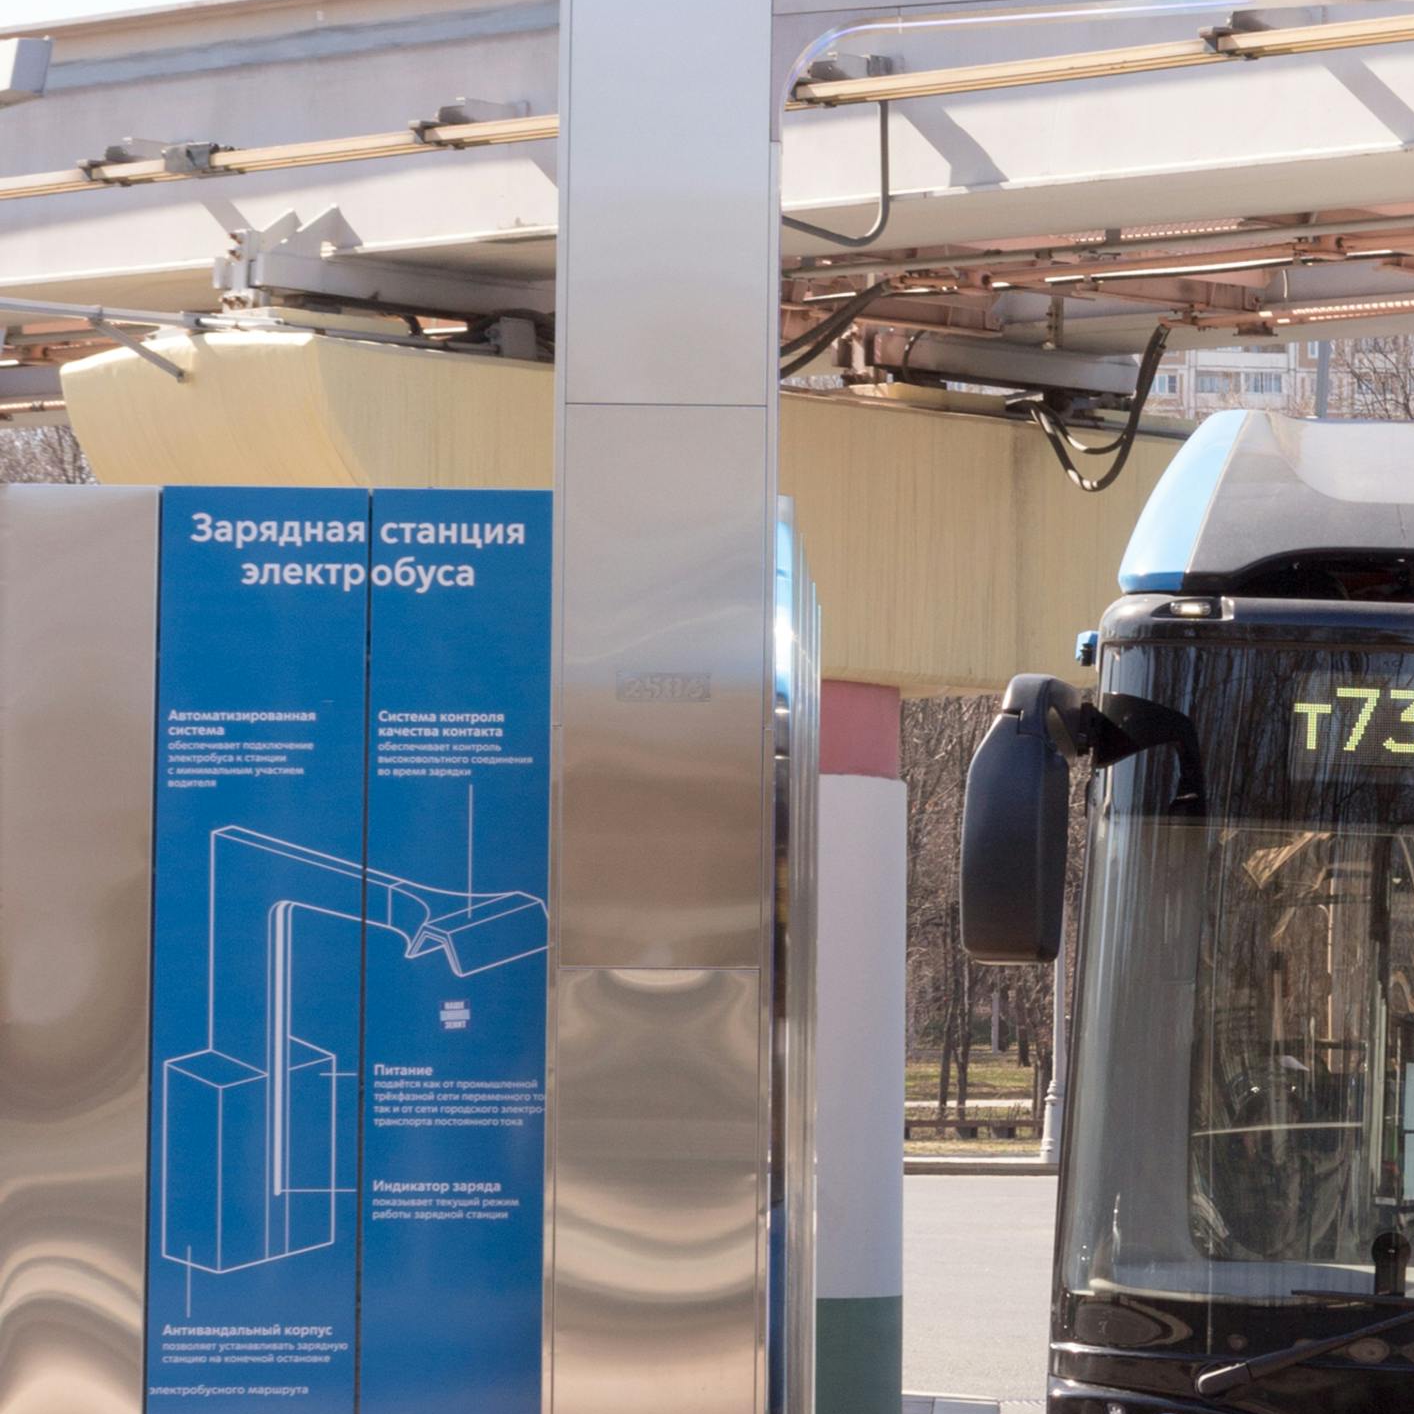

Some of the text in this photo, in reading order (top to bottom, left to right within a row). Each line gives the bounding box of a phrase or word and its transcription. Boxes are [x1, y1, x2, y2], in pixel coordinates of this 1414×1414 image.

[191, 512, 525, 549] Зарядная станция
[241, 556, 475, 593] электробуса
[168, 709, 316, 723] Автоматизированная
[378, 710, 504, 724] Система контроля
[168, 726, 224, 735] система
[378, 727, 503, 737] качества контакта
[452, 744, 501, 752] контроль
[168, 753, 235, 764] электробуса
[244, 755, 287, 763] станции
[392, 768, 427, 777] время
[426, 768, 471, 777] зарядки
[374, 1064, 433, 1076] Питание
[440, 1106, 500, 1114] городского
[374, 1118, 523, 1127] транспорта постоянного тока
[373, 1180, 501, 1194] Индикатор заряда
[435, 1197, 481, 1208] текущий
[483, 1199, 519, 1208] режим
[372, 1209, 508, 1220] работы зарядной станции
[162, 1324, 332, 1338] Антивандальный корпус
[218, 1343, 295, 1352] устанавливать
[297, 1343, 348, 1352] зарядную
[223, 1354, 274, 1363] конечной
[276, 1355, 330, 1363] остановке
[148, 1385, 308, 1396] электробусного маршрута
